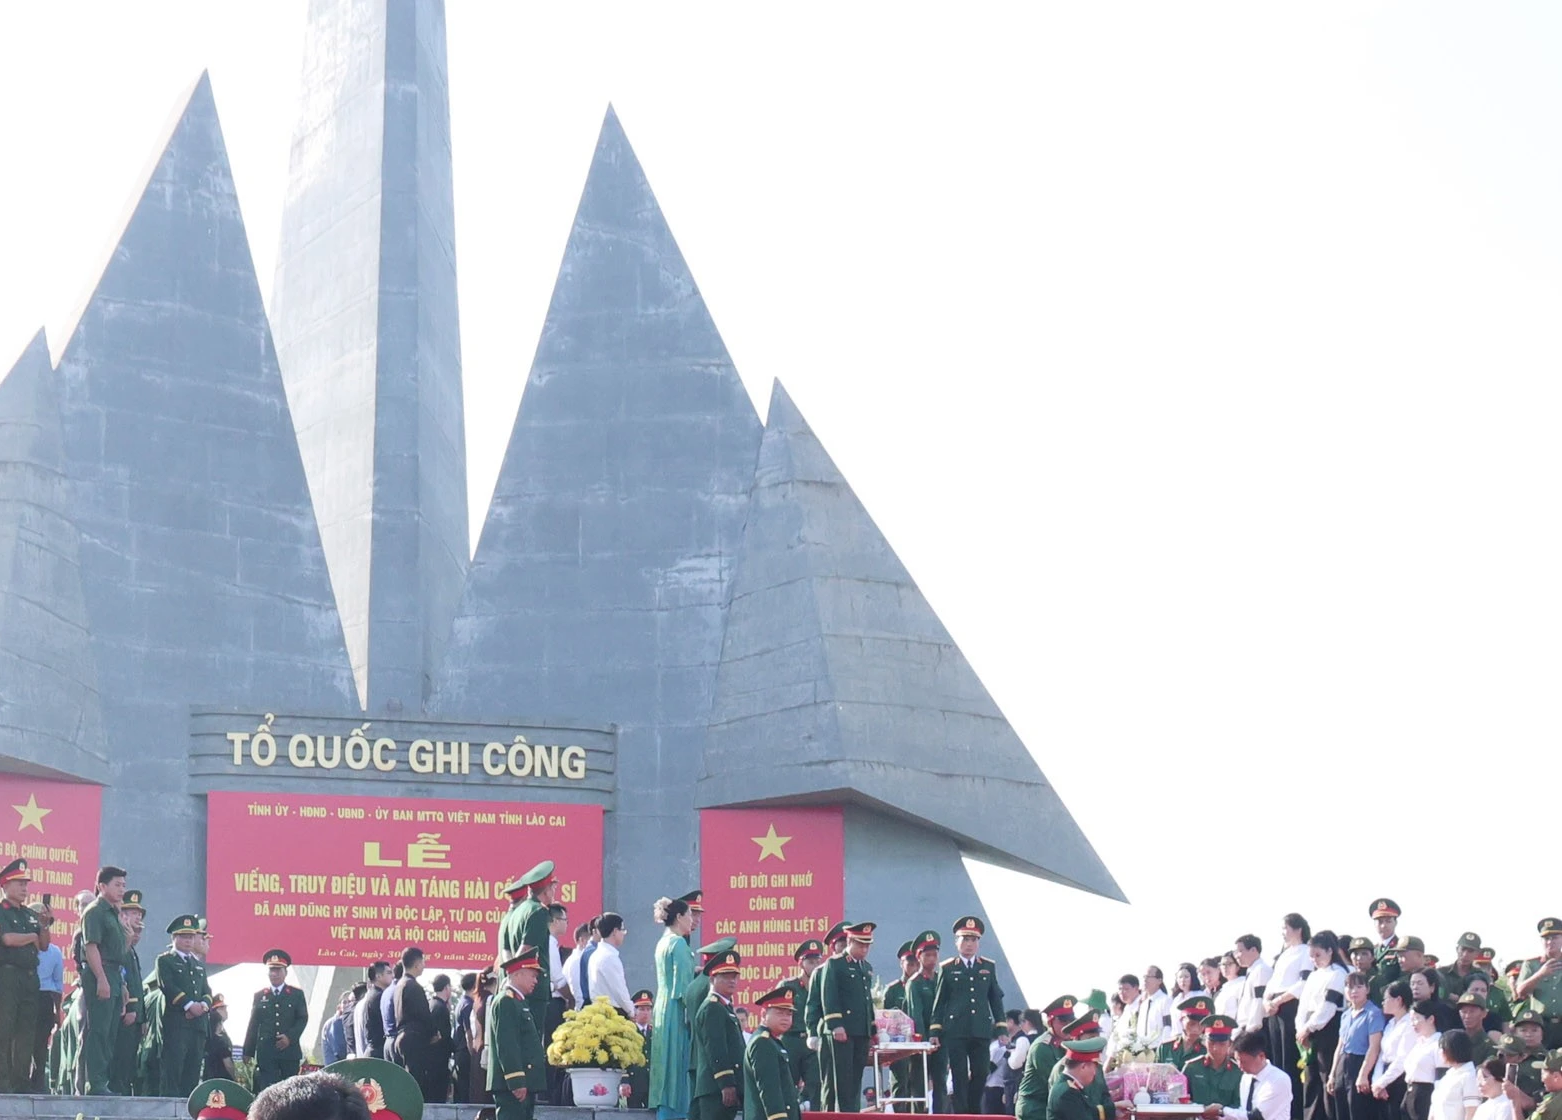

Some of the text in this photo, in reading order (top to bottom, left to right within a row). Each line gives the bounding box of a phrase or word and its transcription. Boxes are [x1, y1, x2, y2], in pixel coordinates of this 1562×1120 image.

[227, 712, 587, 780] TỔ QUỐC GHI CÔNG
[299, 806, 327, 818] HĐND
[338, 807, 365, 819] UBND
[393, 809, 413, 821] BAN
[417, 810, 444, 823] MTTQ
[447, 810, 471, 826] VIỆT
[474, 813, 496, 825] NAM
[499, 811, 522, 825] TỈNH
[526, 813, 546, 826] LÀO
[549, 815, 566, 827] CAI
[21, 844, 47, 860] CHÍNH
[364, 832, 451, 869] LỄ
[46, 869, 73, 886] TRANG
[234, 866, 285, 895] VIẾNG,
[288, 874, 327, 894] TRUY
[331, 872, 367, 899] ĐIỆU
[370, 874, 391, 896] VÀ
[394, 878, 416, 897] AN
[420, 875, 460, 899] TÁNG
[464, 876, 490, 900] HÀI
[561, 881, 577, 903] SĨ
[771, 874, 788, 888] GHI
[790, 869, 813, 887] NHỚ
[254, 900, 270, 916] ĐÃ
[273, 904, 296, 917] ANH
[300, 902, 331, 918] DŨNG
[333, 905, 349, 918] HY
[352, 906, 378, 919] SINH
[381, 904, 392, 919] VÌ
[395, 904, 418, 922] ĐỘC
[421, 905, 446, 924] LẬP,
[449, 907, 465, 924] TỰ
[467, 909, 483, 923] DO
[749, 895, 795, 911] CÔNG ƠN
[330, 923, 486, 944] VIỆT NAM XÃ HỘI CHỦ NGHĨA
[716, 915, 829, 935] CÁC ANH HÙNG LIỆT SĨ
[756, 940, 785, 957] DŨNG
